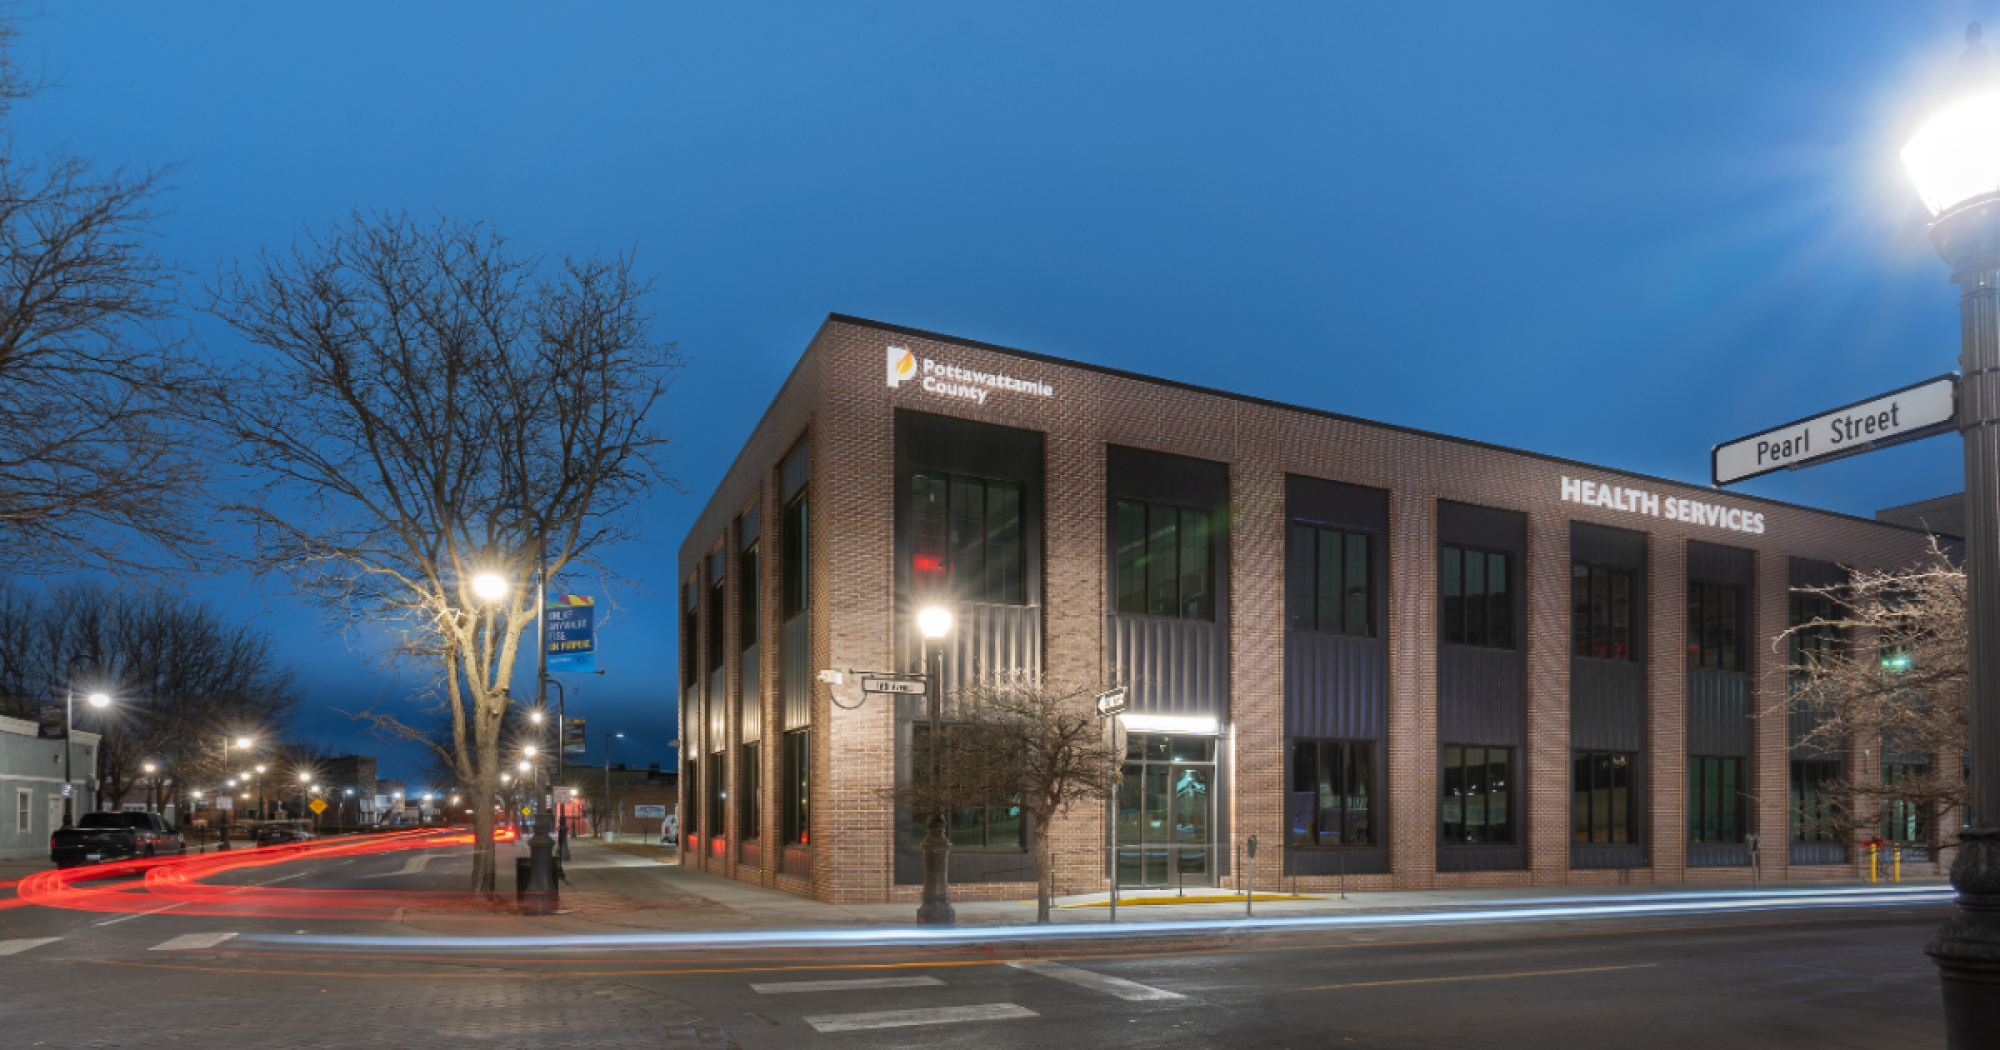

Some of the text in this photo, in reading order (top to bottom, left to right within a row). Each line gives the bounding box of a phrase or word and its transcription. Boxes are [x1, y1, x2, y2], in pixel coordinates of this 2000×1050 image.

[922, 357, 1053, 396] Pottawattamie
[922, 376, 988, 405] County
[1757, 402, 1900, 465] Pearl Street
[1561, 476, 1766, 534] HEALTH SERVICES
